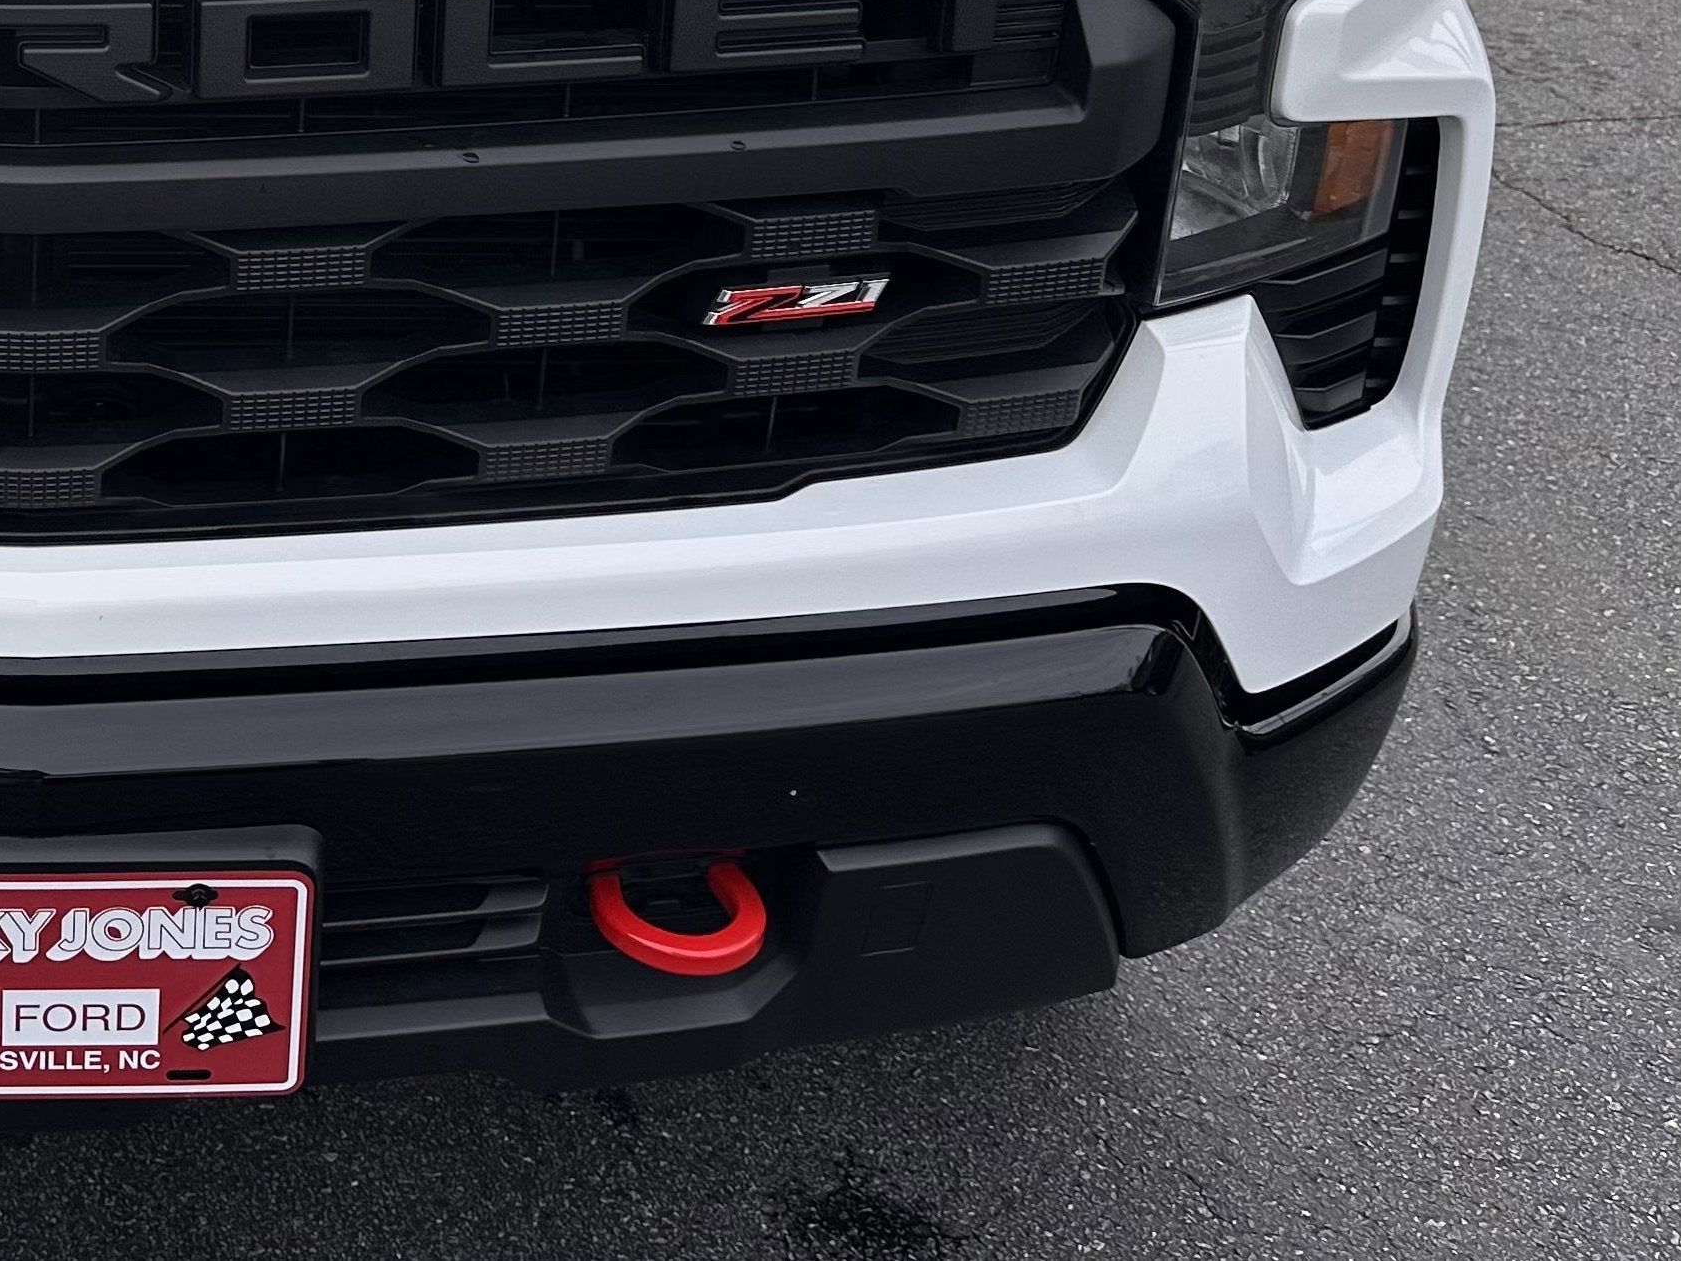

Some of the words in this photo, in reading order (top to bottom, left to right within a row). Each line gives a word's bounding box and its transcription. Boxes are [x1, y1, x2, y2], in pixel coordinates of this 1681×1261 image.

[702, 277, 891, 326] Z71
[46, 905, 275, 961] JONES
[14, 1003, 147, 1032] FORD
[119, 1049, 161, 1070] NC
